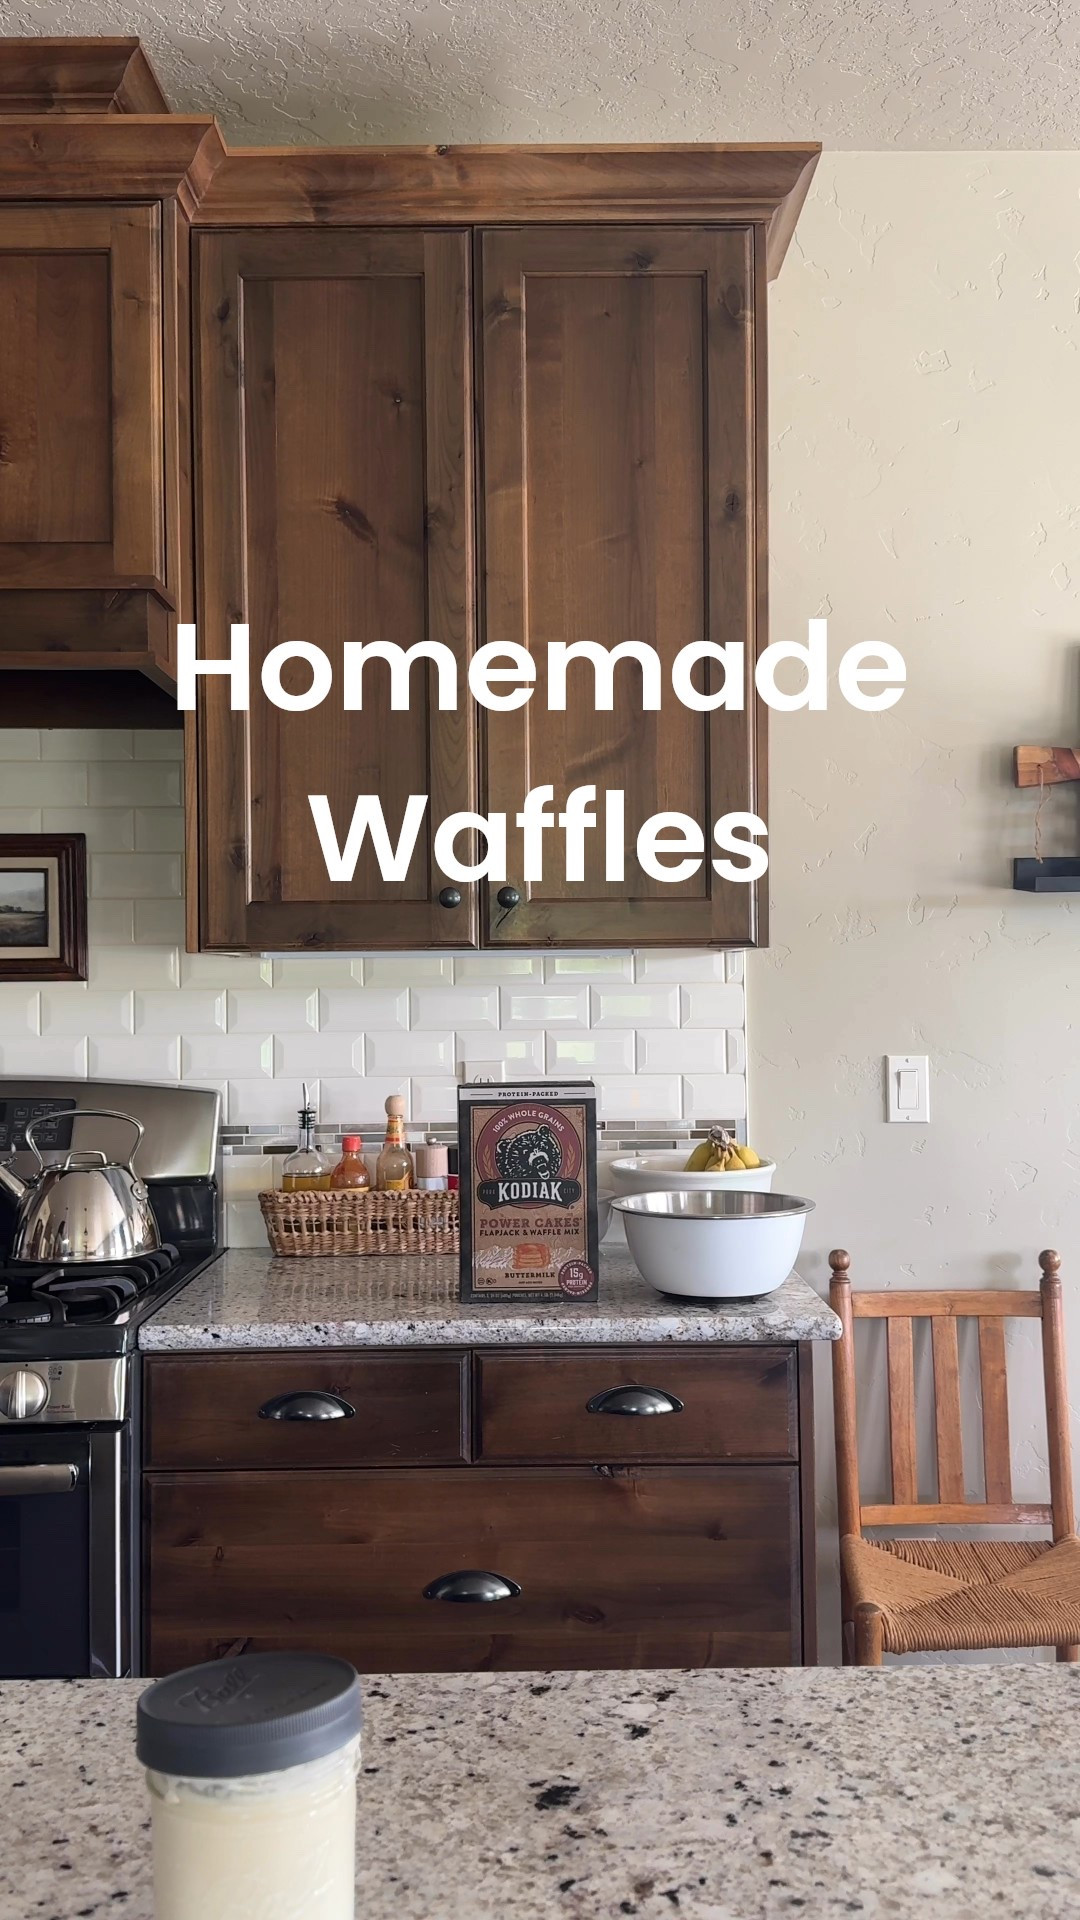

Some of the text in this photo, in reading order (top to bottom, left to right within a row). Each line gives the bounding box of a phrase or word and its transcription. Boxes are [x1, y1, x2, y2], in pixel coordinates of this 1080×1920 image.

[492, 1110, 565, 1133] 100% WHOLE GRAINS
[498, 1181, 563, 1202] KODIAK
[480, 1217, 580, 1229] POWER CAKES
[504, 1271, 555, 1279] BUTTERMILK
